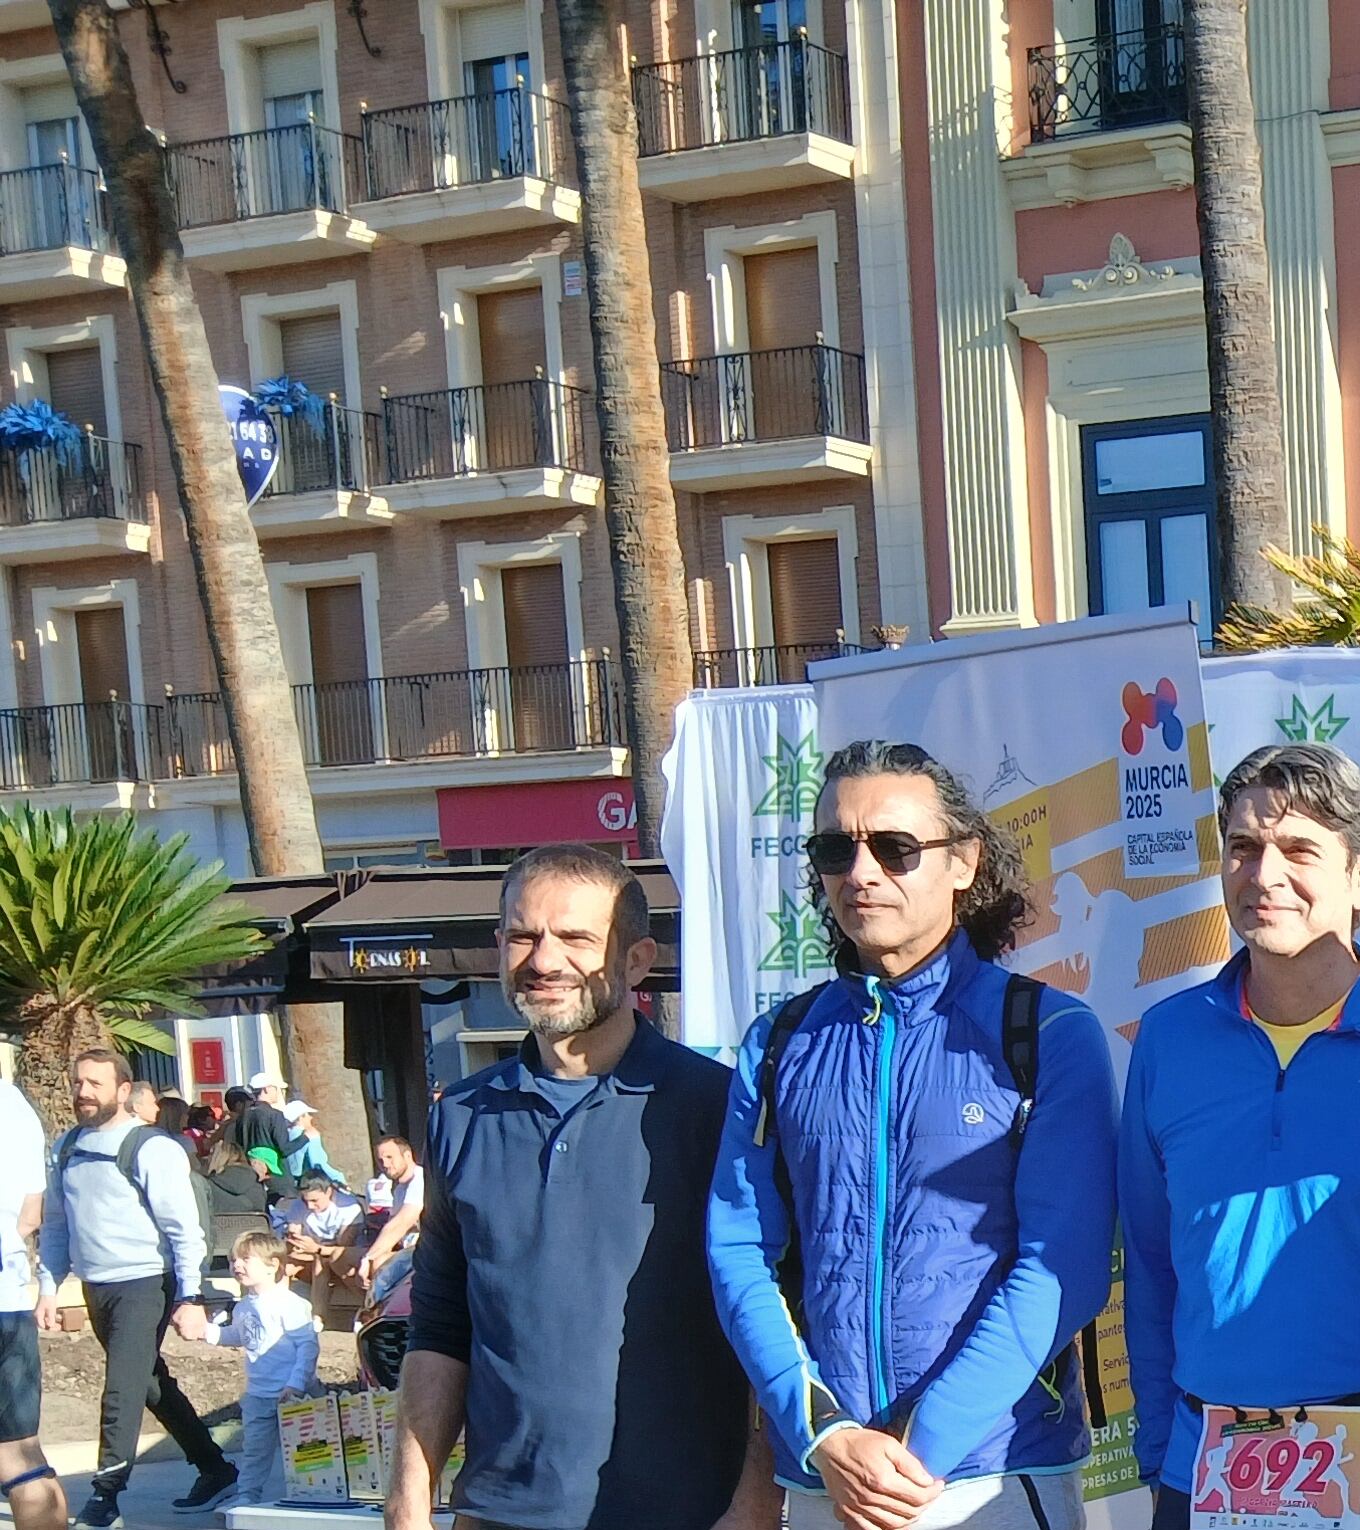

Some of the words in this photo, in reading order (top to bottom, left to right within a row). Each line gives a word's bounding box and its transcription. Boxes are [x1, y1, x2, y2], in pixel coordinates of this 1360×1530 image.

[1125, 763, 1189, 793] MURCIA
[1126, 793, 1163, 819] 2025
[1120, 1467, 1134, 1481] DE
[1228, 1438, 1335, 1493] 692
